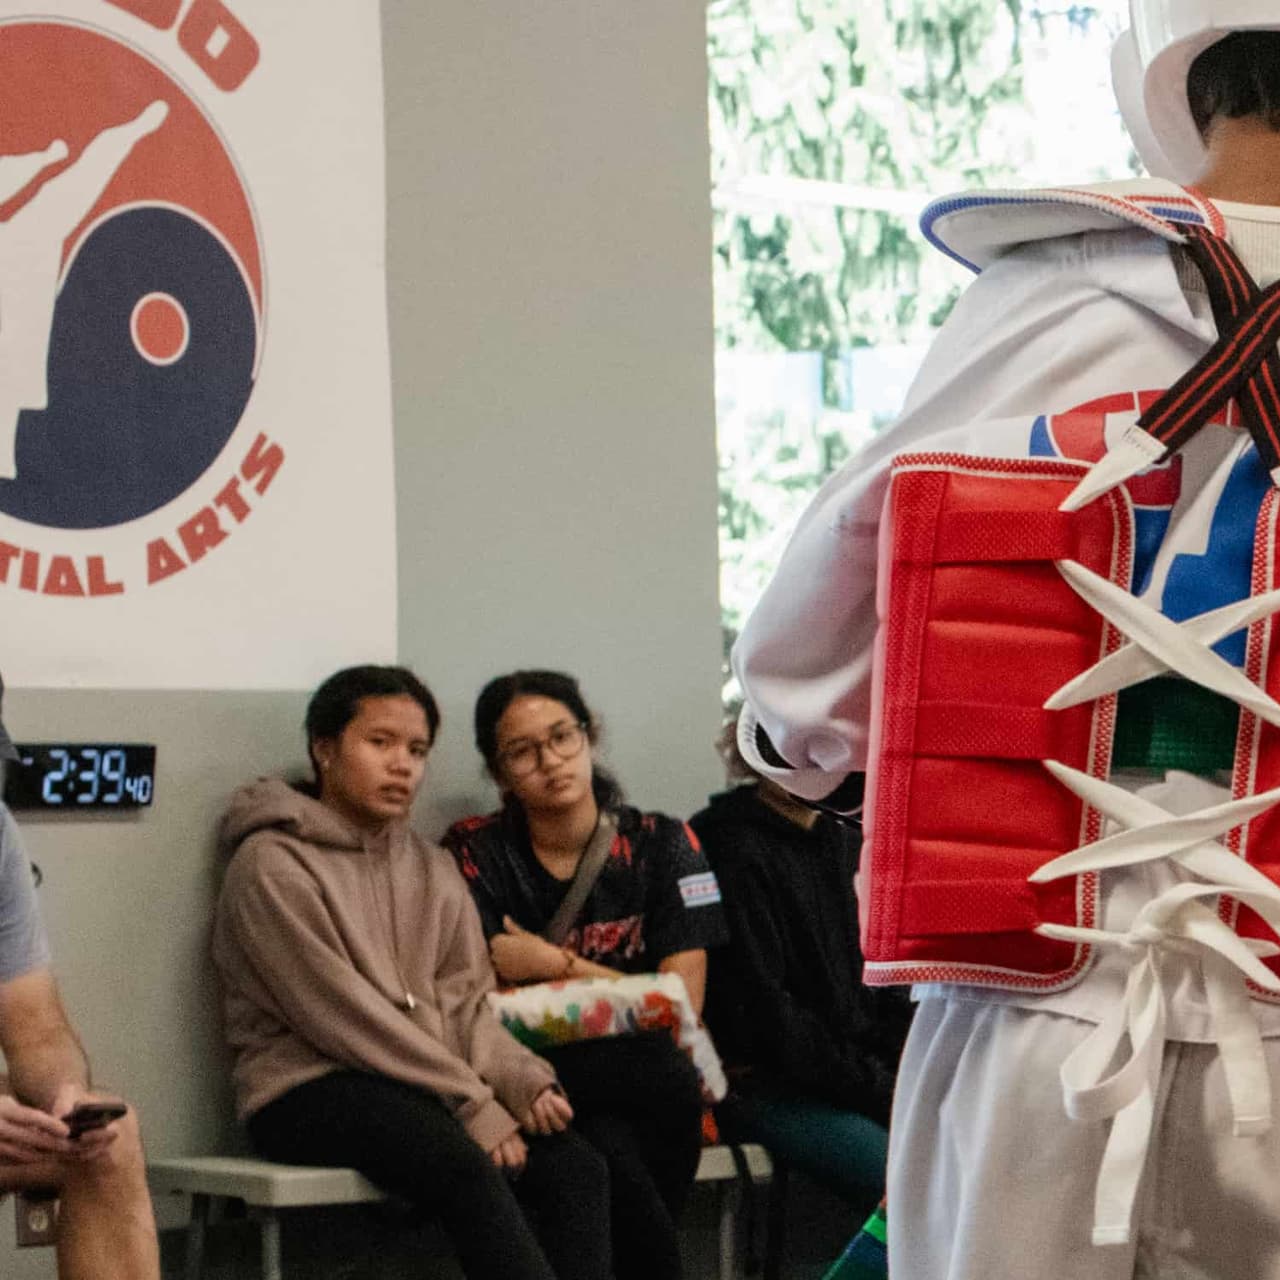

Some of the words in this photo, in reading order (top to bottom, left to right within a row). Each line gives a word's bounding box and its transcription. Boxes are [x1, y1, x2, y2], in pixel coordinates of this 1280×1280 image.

[147, 431, 285, 586] ARTS
[42, 748, 126, 803] 2:39
[125, 775, 152, 803] 40
